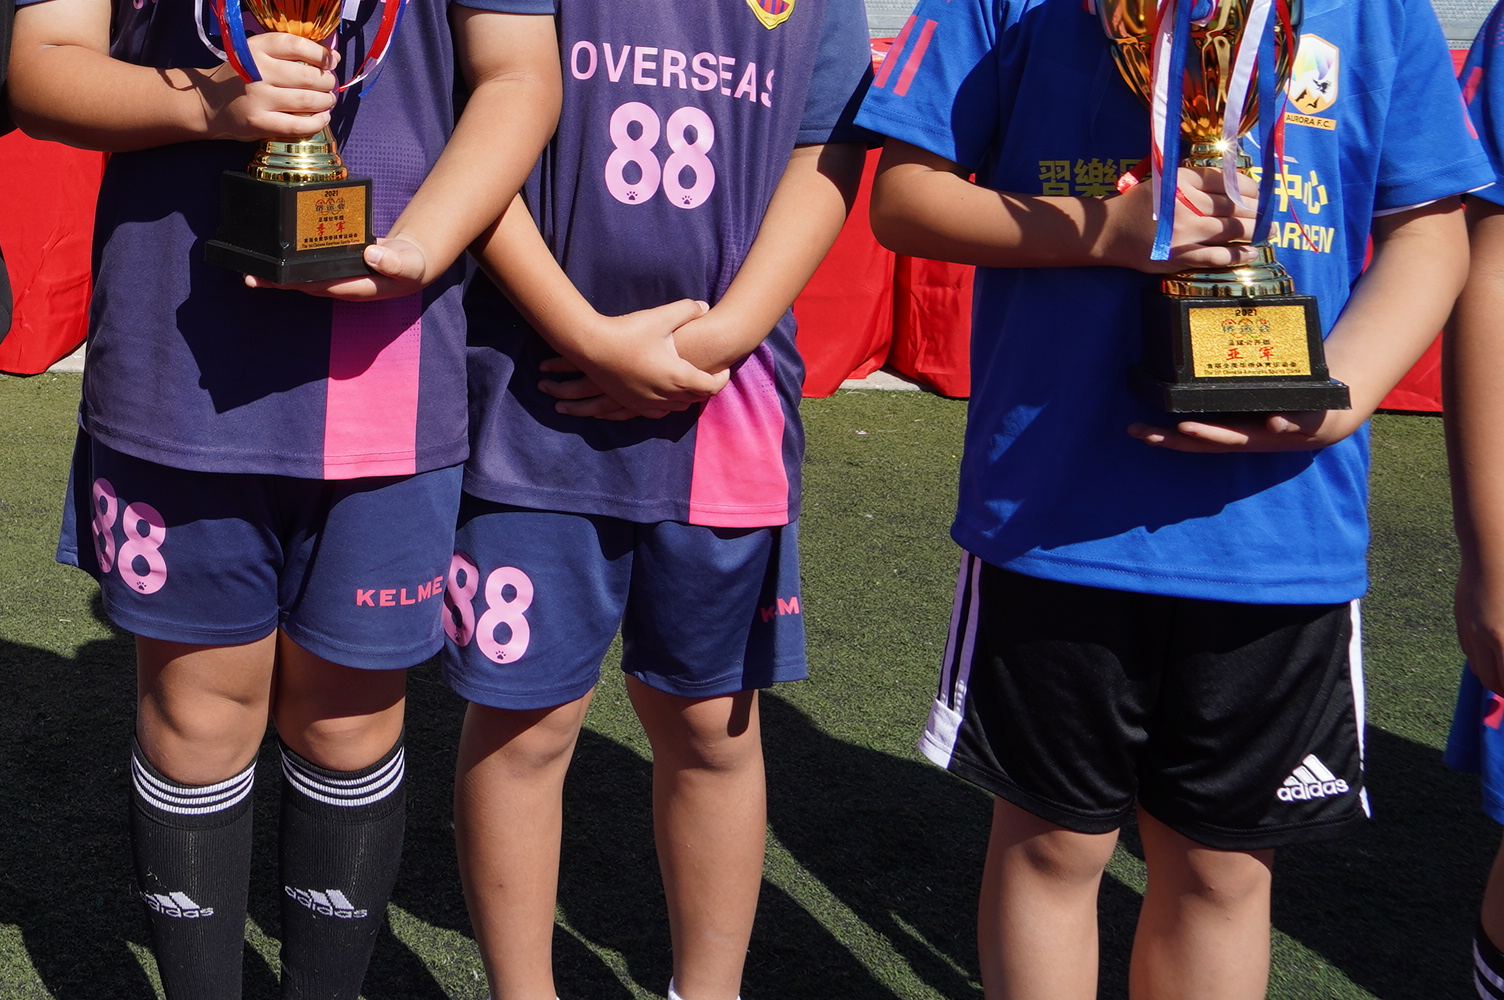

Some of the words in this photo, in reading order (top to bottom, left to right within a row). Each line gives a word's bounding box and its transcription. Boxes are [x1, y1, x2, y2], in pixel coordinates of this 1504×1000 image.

[570, 40, 775, 108] OVERSEAS
[1285, 113, 1315, 126] AURORA
[1316, 119, 1331, 129] F.C.
[604, 101, 716, 210] 88
[324, 189, 339, 197] 2021
[1269, 221, 1336, 254] ARDEN
[1235, 308, 1257, 317] 2021
[92, 477, 168, 595] 88
[356, 575, 444, 607] KELME
[442, 551, 535, 665] 88
[1276, 778, 1350, 802] adidas
[284, 885, 368, 919] adidas
